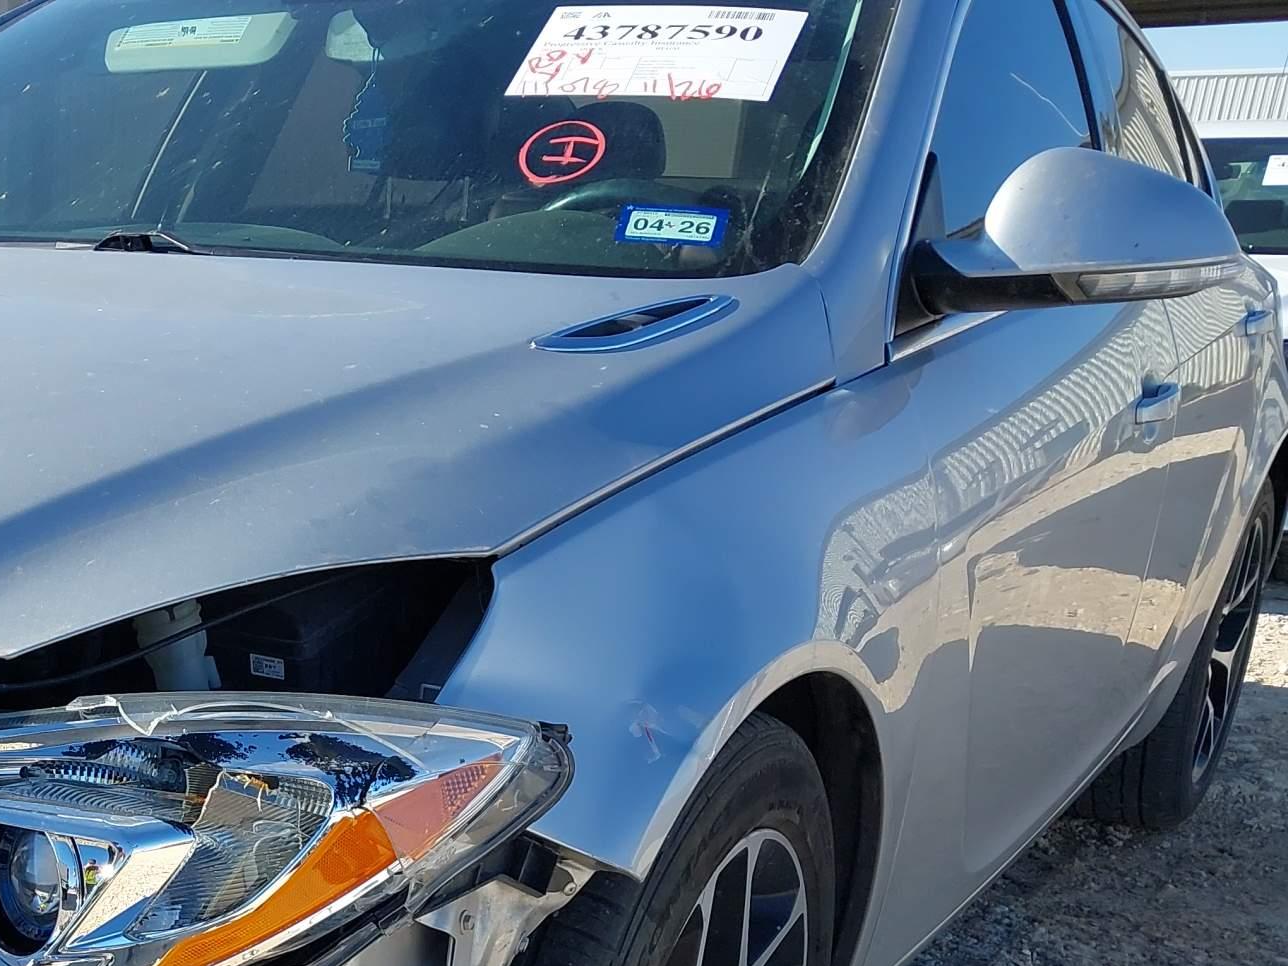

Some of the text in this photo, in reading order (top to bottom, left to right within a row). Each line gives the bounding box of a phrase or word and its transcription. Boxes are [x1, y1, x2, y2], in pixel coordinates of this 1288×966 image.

[563, 24, 764, 42] 43787590
[633, 217, 712, 235] 04 26
